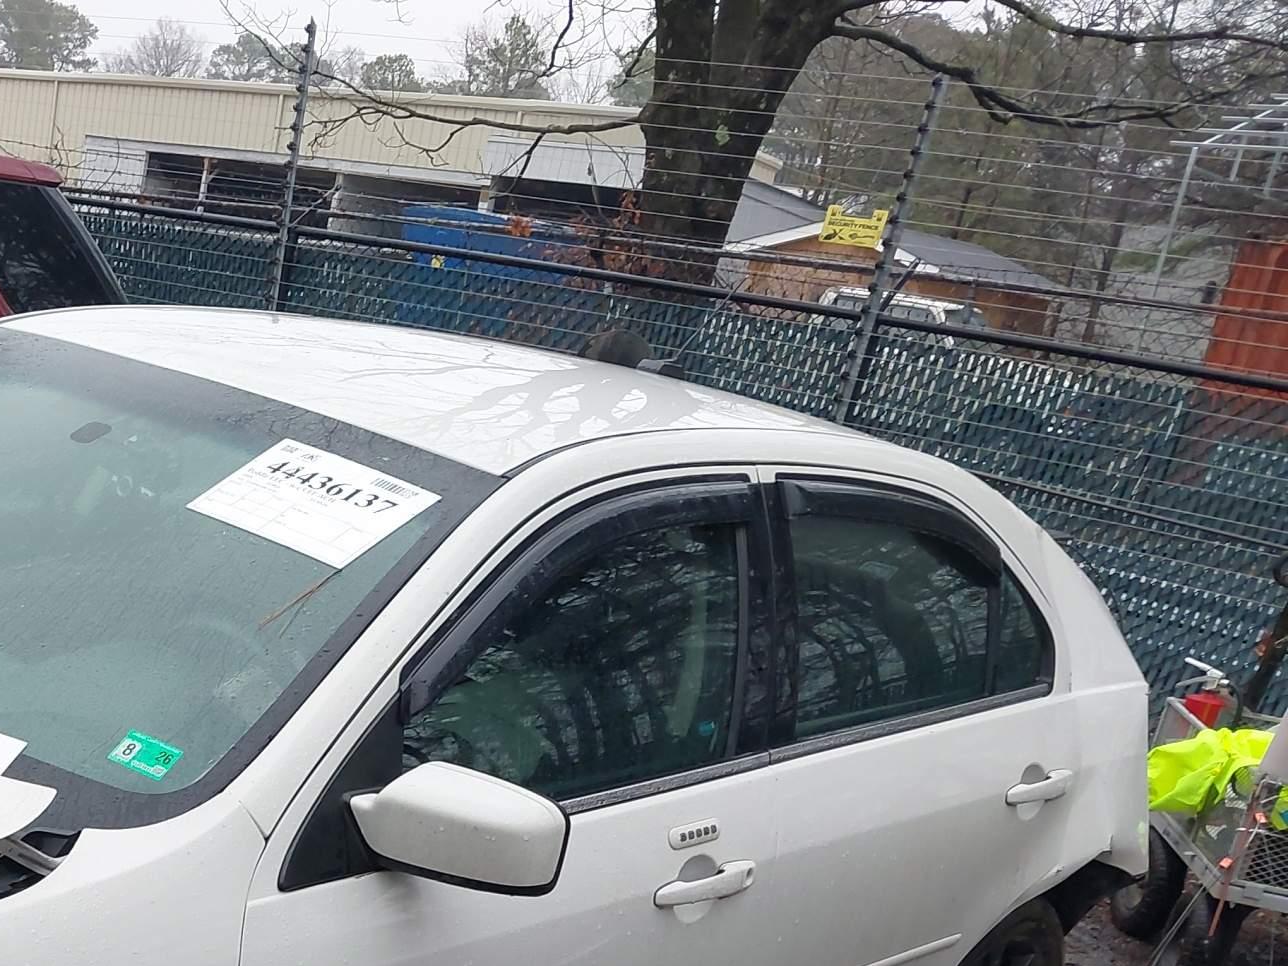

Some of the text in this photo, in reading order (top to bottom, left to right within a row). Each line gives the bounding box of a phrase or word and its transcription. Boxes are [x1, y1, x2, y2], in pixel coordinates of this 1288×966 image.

[859, 223, 880, 231] FENCE
[267, 461, 400, 514] 44436137
[122, 743, 174, 765] 8 26
